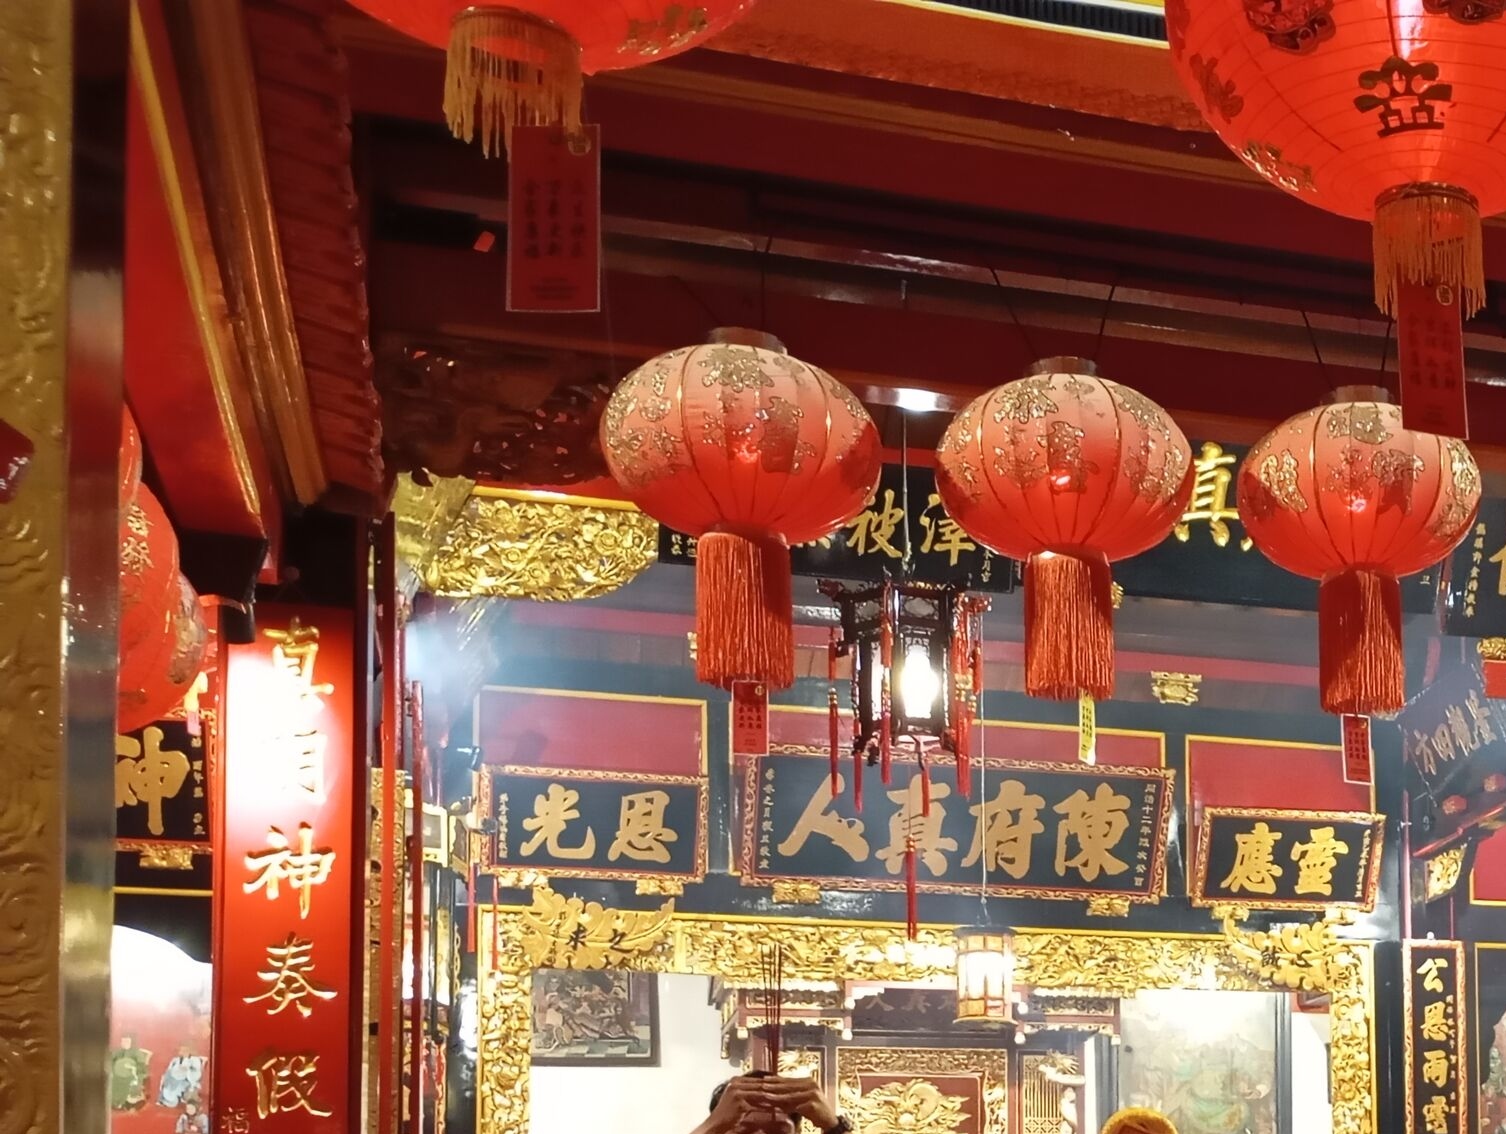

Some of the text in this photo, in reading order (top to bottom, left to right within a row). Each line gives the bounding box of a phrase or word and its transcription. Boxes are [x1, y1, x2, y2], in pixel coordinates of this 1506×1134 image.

[519, 783, 680, 864] 恩光
[777, 772, 1133, 881] 陳府真人
[1220, 821, 1349, 896] 靈應
